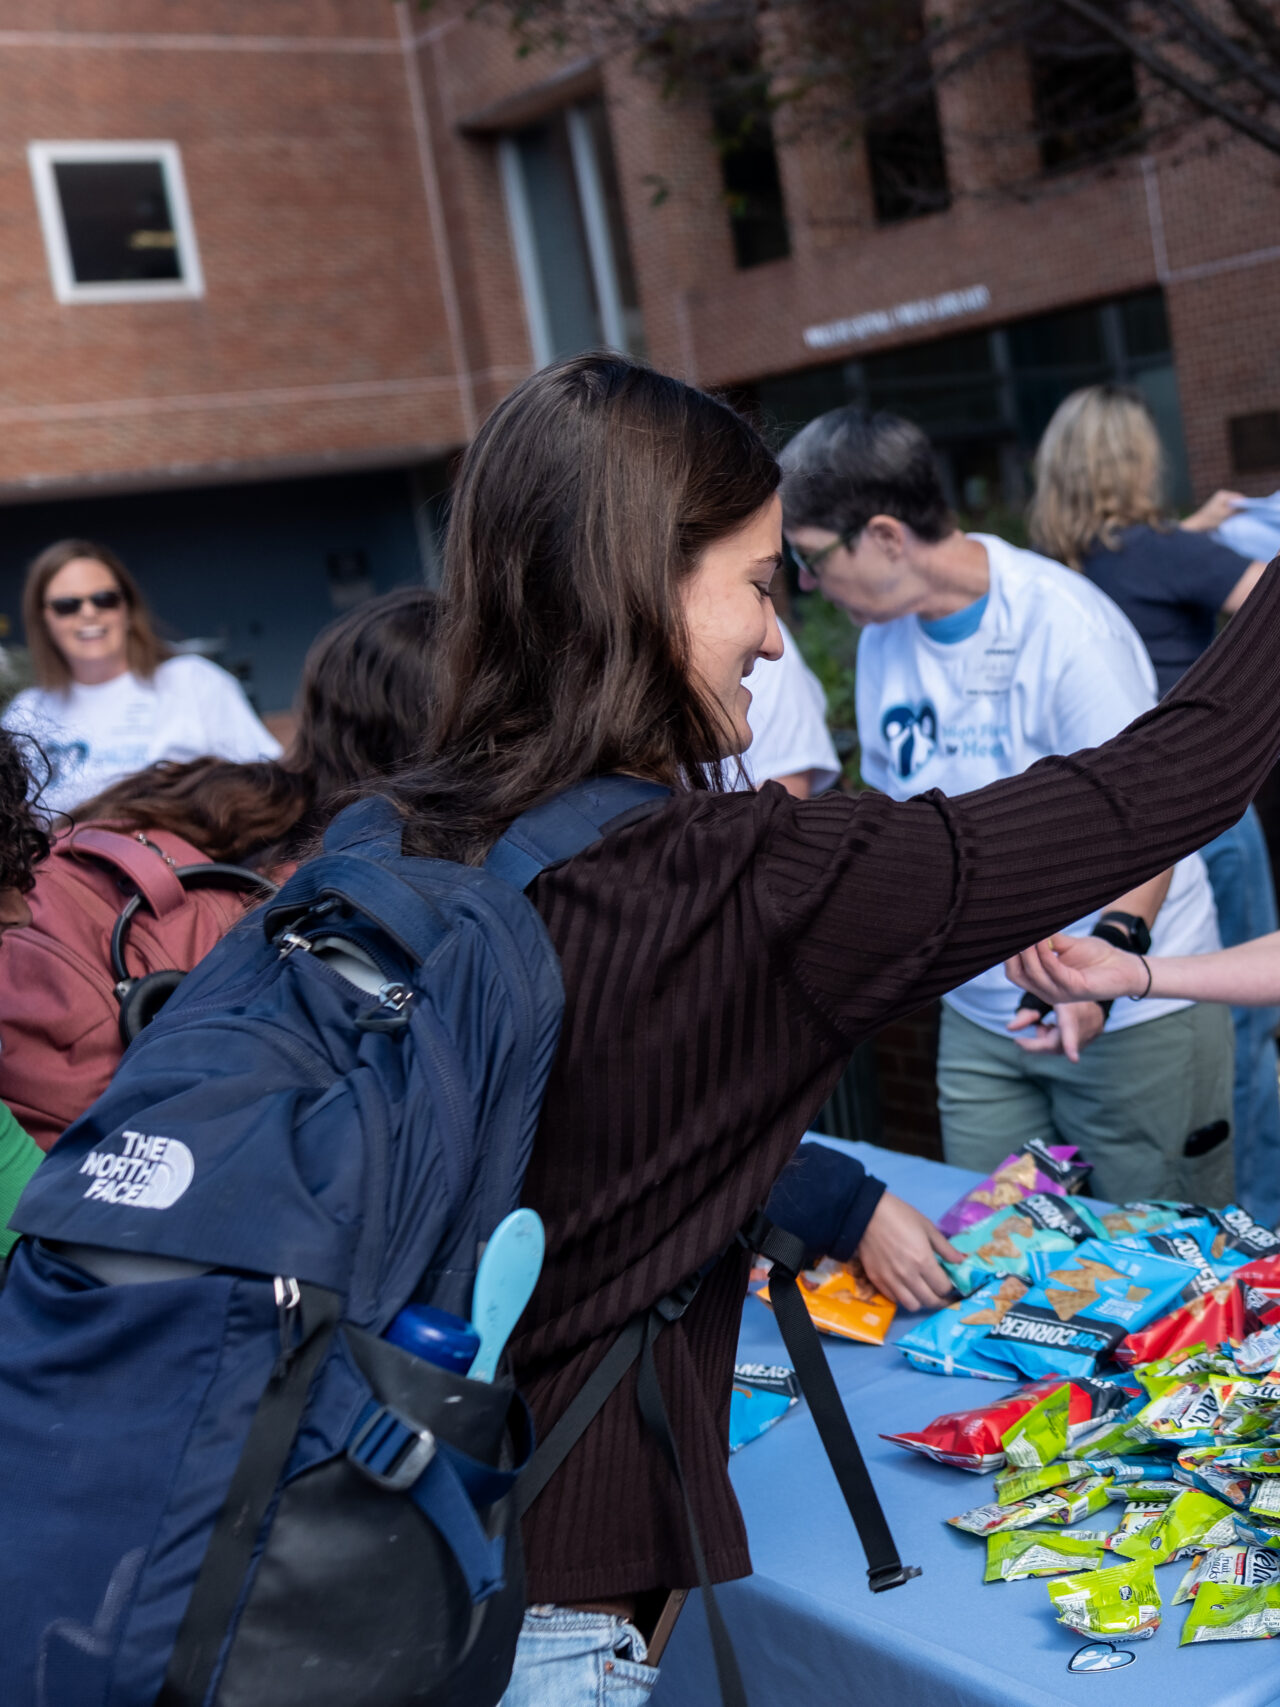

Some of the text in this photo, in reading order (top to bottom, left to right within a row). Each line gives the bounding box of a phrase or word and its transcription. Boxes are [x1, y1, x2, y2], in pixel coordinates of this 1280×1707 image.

[122, 1130, 169, 1162] THE
[79, 1151, 158, 1184] NORTH
[82, 1178, 145, 1206] FACE
